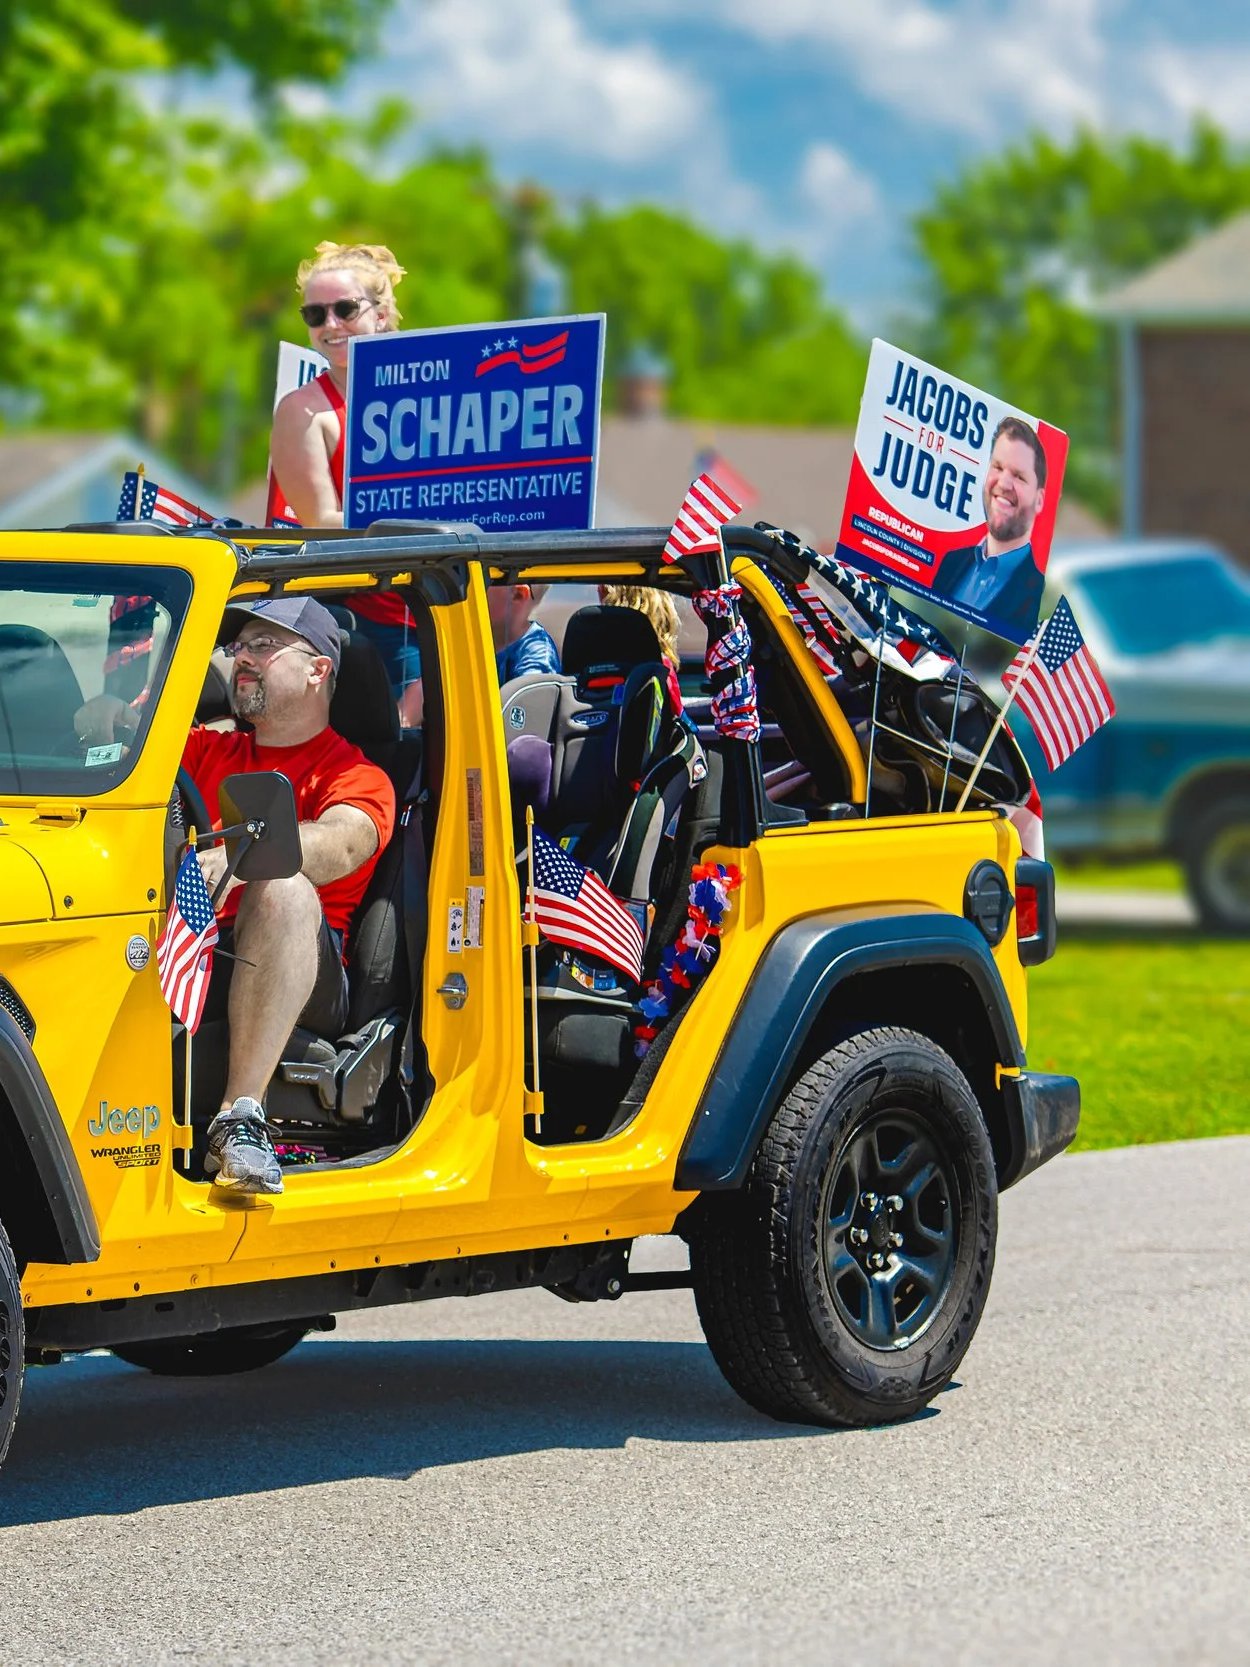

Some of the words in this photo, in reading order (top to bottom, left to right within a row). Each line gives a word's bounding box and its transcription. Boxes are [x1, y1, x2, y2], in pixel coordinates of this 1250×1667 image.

[374, 359, 450, 388] MILTON
[886, 360, 989, 450] JACOBS
[361, 384, 584, 464] SCHAPER
[918, 427, 945, 455] FOR
[356, 486, 412, 514] STATE
[418, 472, 582, 508] REPRESENTATIVE
[873, 431, 977, 522] JUDGE
[868, 506, 924, 543] REPUBLICAN
[88, 1101, 161, 1139] Jeep
[90, 1144, 161, 1158] WRANGLER
[113, 1152, 161, 1160] UNLIMITED
[115, 1159, 159, 1168] SPORT
